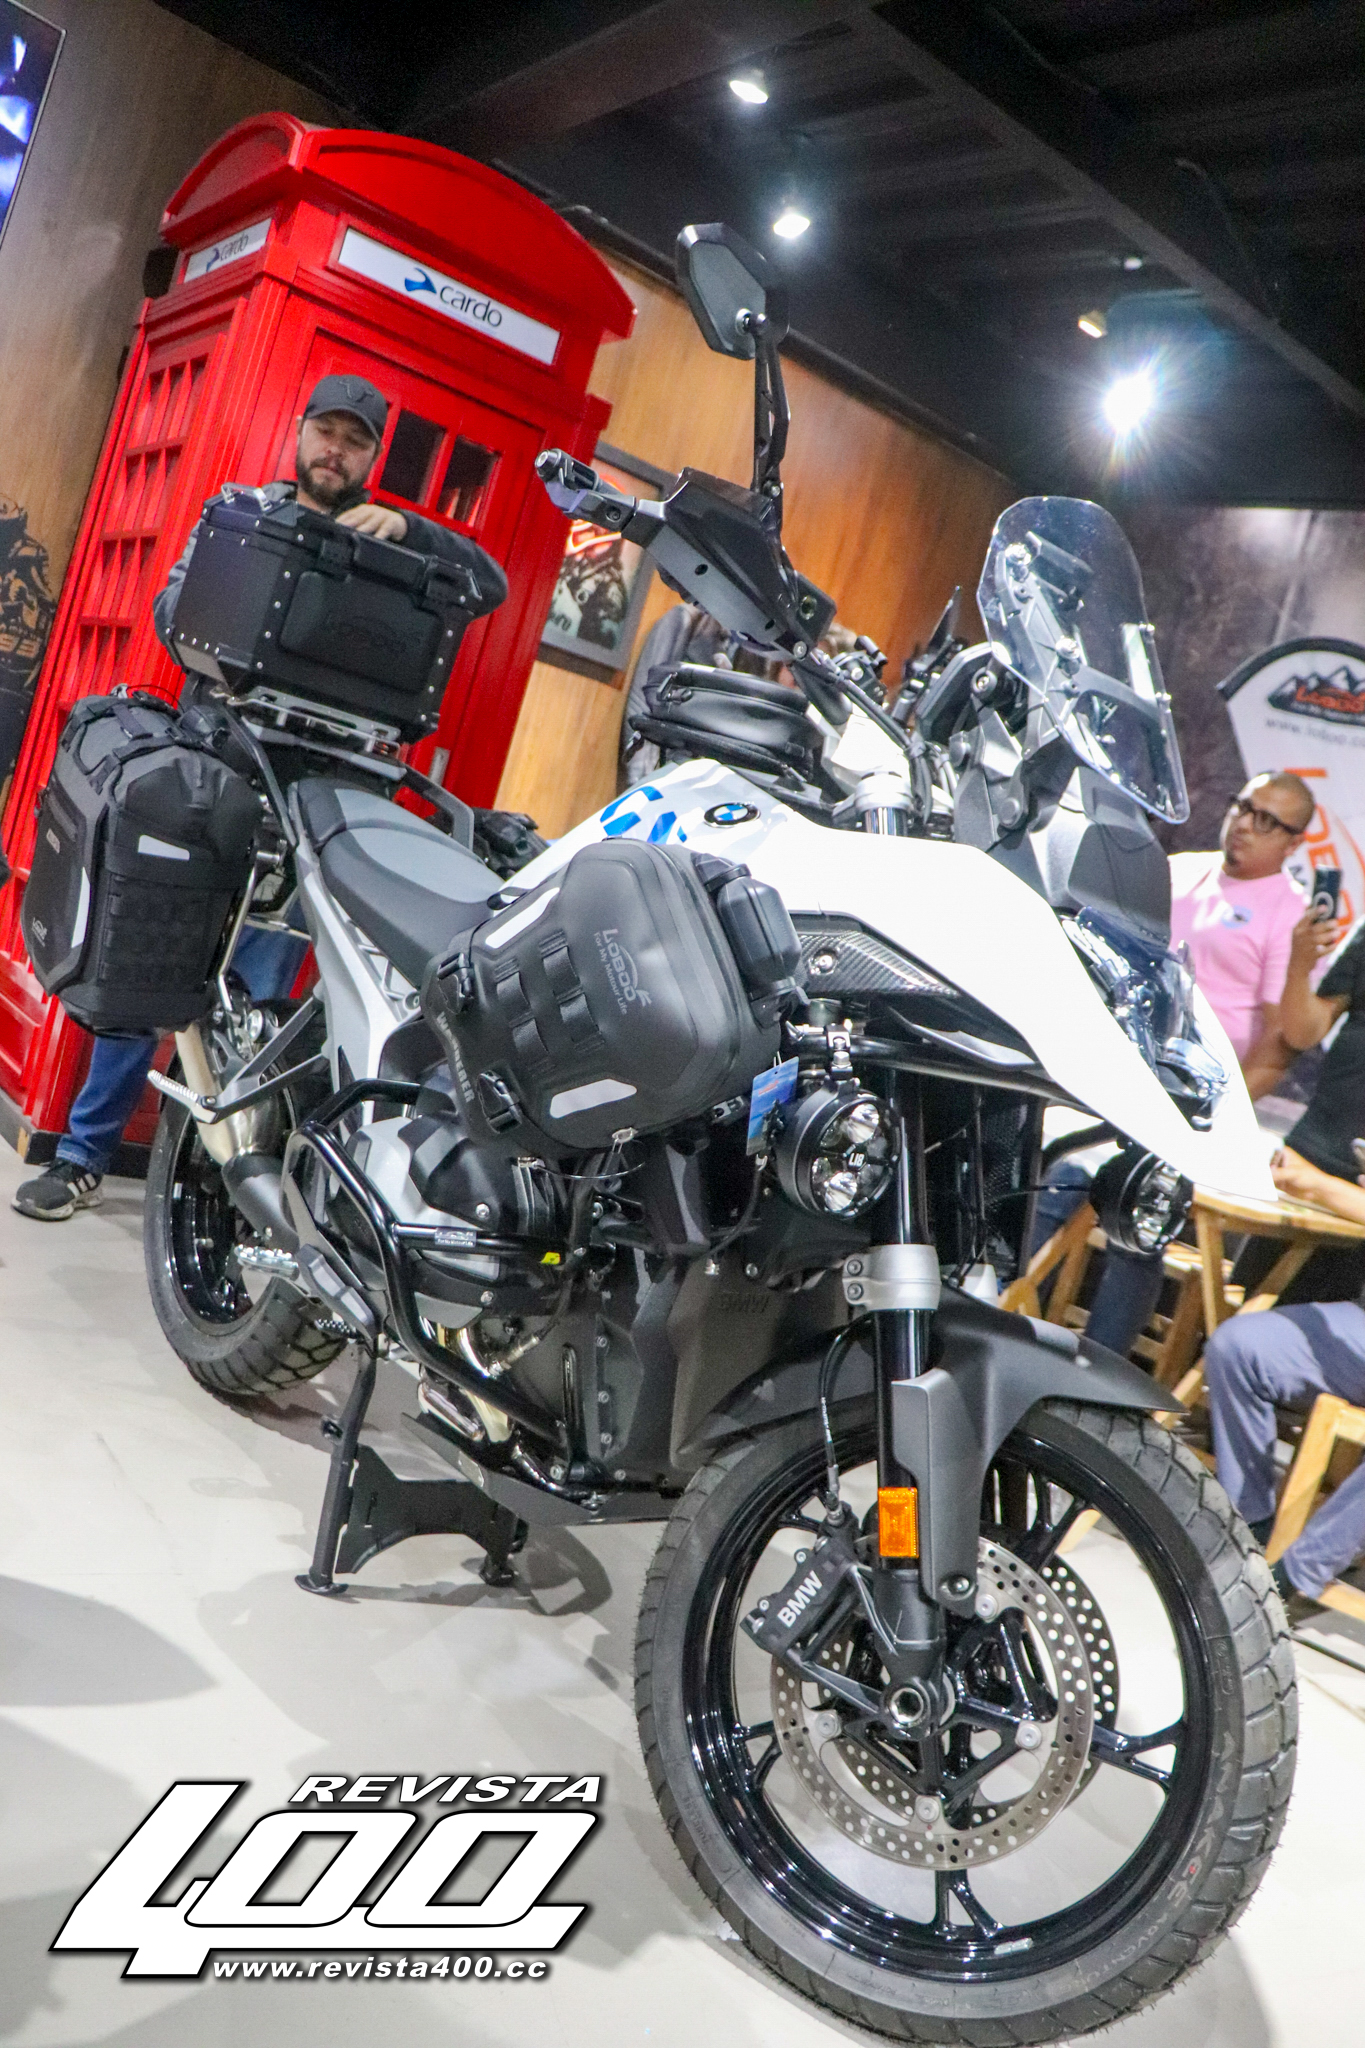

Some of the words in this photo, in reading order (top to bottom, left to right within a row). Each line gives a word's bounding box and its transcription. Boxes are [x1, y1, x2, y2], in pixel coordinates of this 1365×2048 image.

[439, 285, 503, 328] cardo
[594, 932, 603, 947] For
[617, 997, 628, 1015] Life
[777, 1570, 822, 1628] BMW
